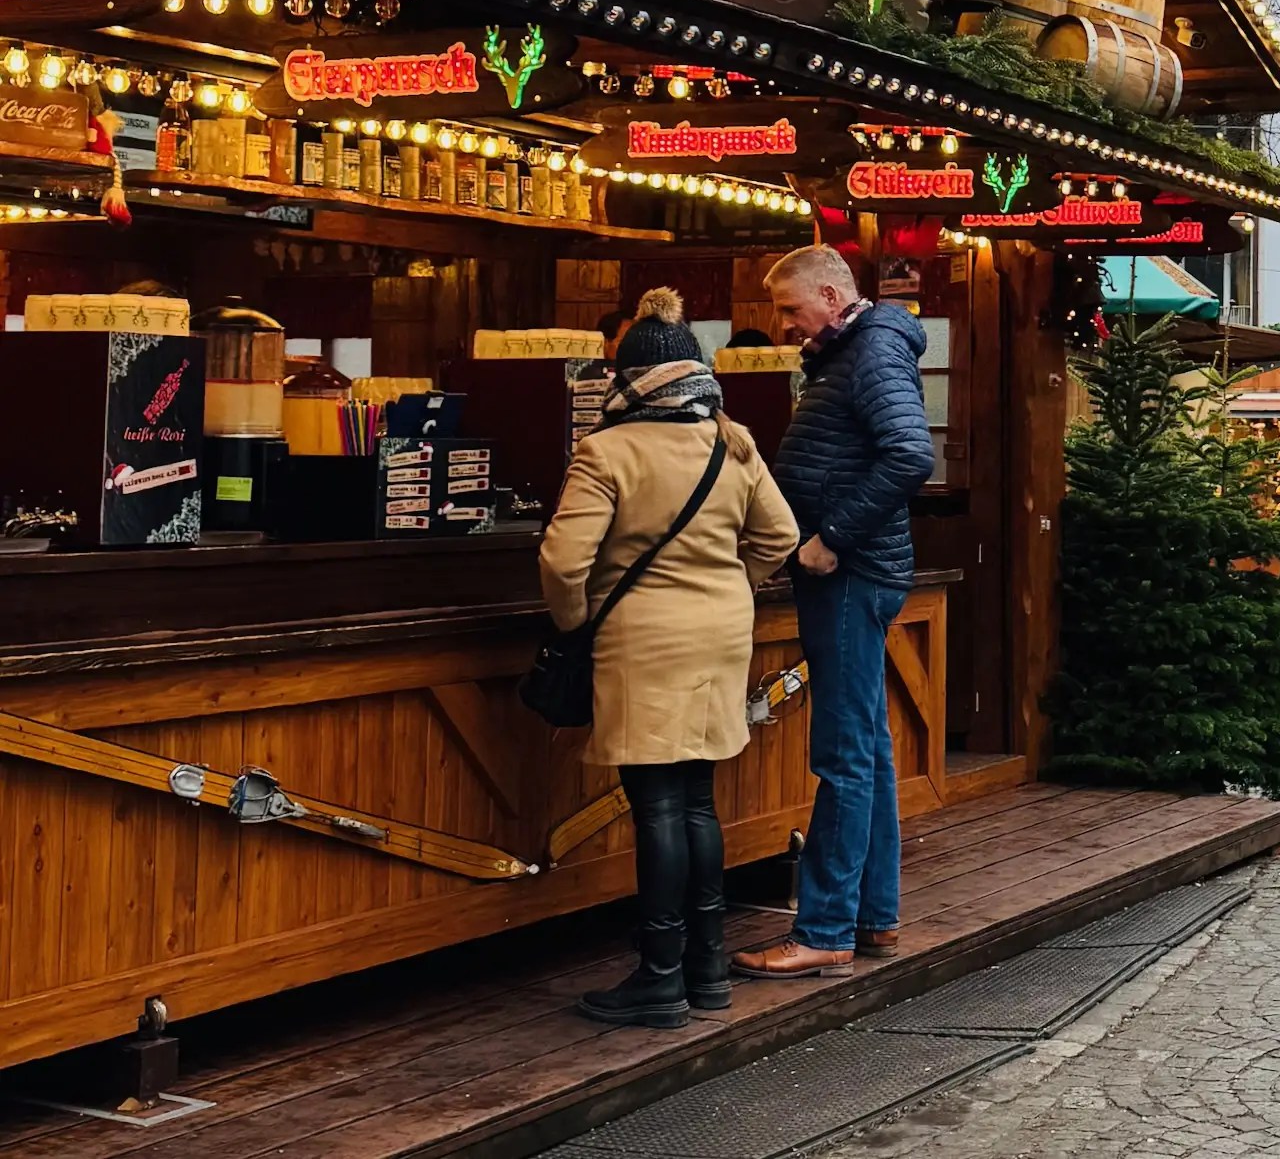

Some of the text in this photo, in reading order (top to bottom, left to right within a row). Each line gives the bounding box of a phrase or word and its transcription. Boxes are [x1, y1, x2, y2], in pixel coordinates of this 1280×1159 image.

[284, 42, 479, 107] Eierpunsch
[628, 118, 797, 162] Kinderpunsch
[847, 162, 974, 198] Glühwein
